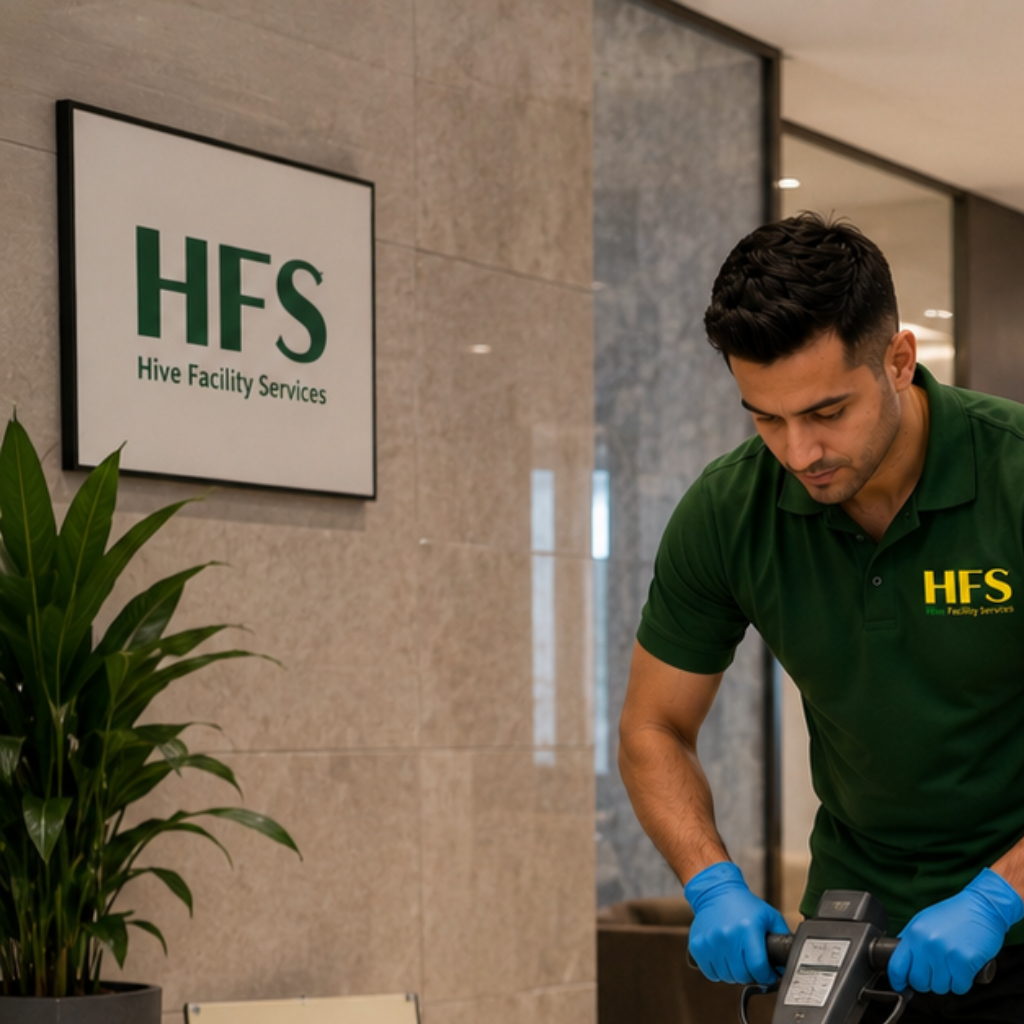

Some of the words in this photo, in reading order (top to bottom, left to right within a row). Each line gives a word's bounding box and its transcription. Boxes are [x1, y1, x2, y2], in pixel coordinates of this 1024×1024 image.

[136, 225, 327, 364] HFS
[138, 356, 182, 384] Hive
[188, 364, 254, 399] Facility
[259, 375, 327, 405] Services
[924, 568, 1013, 604] HFS
